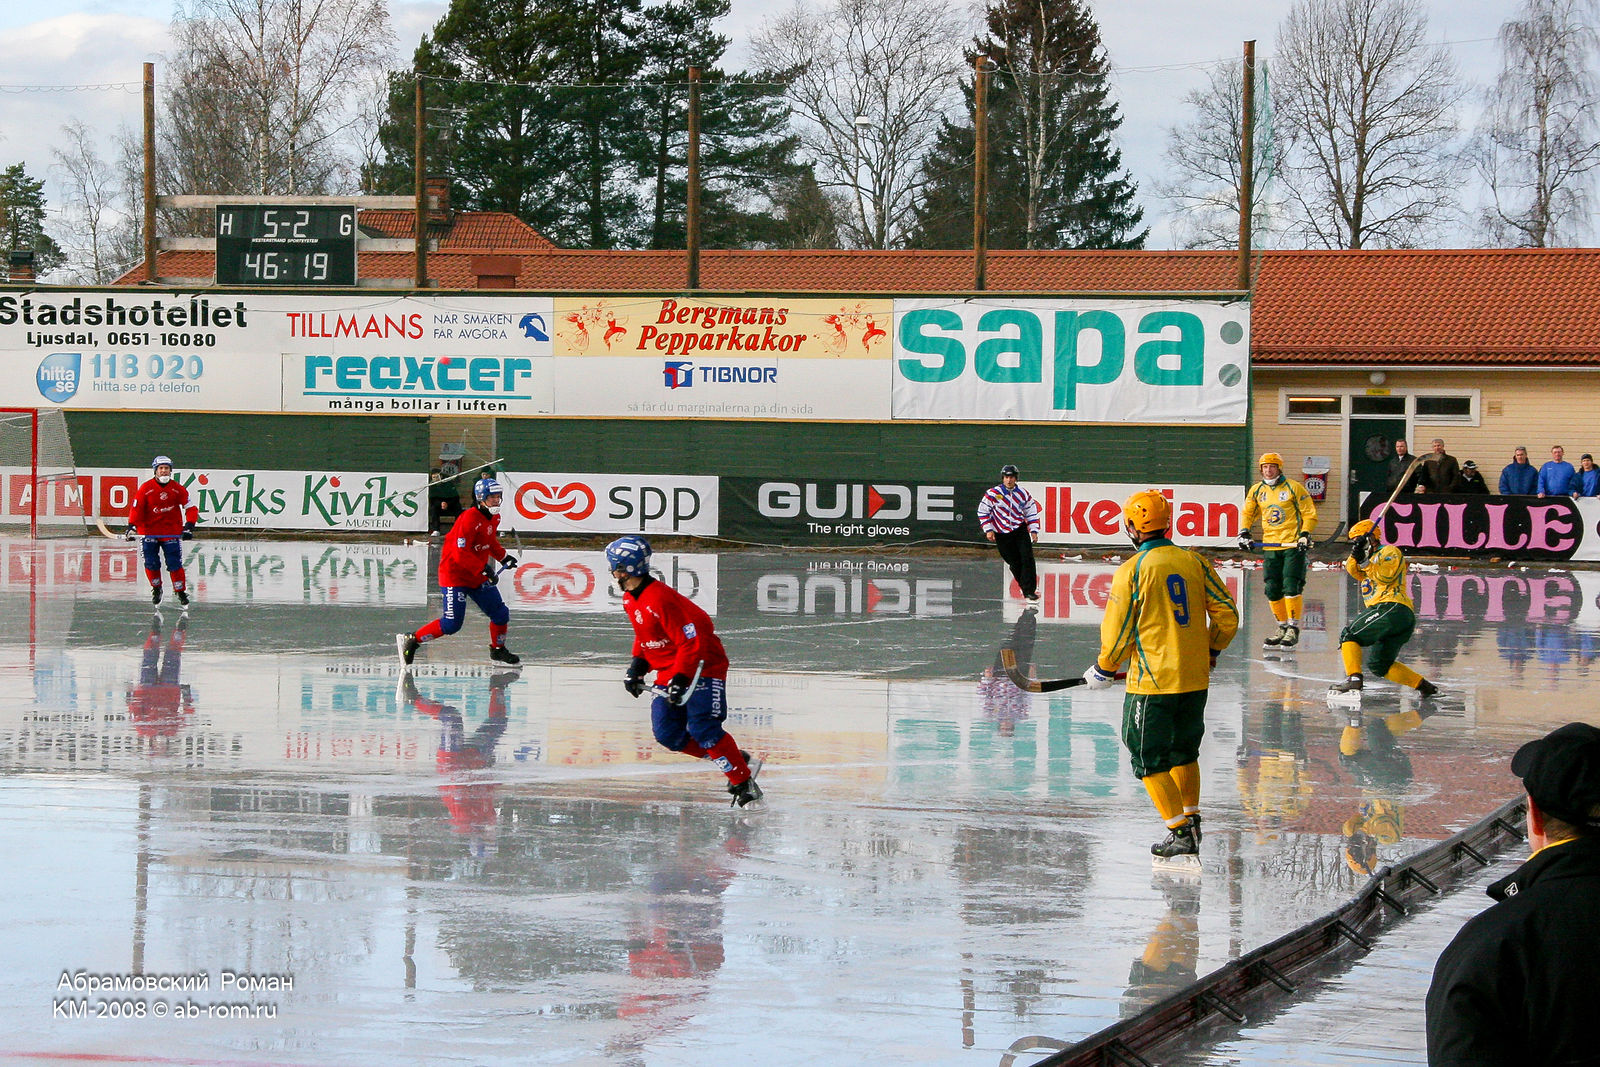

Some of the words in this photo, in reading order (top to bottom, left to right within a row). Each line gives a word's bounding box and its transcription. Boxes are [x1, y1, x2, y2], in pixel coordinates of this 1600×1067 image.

[220, 213, 233, 235] H
[263, 210, 310, 238] 5-2
[339, 214, 352, 236] G
[245, 252, 329, 280] 46:19
[0, 296, 248, 328] Stadshotellet
[433, 311, 459, 325] NÄR
[463, 313, 513, 325] SMAKEN
[655, 299, 789, 330] Bergmans
[286, 313, 424, 340] TILLMANS
[458, 326, 508, 340] AVGÖRA
[26, 331, 99, 348] Ljusdal,
[107, 331, 216, 348] 0651-16080
[636, 325, 807, 356] Pepparkakor
[40, 366, 75, 381] hitta
[89, 353, 139, 379] 118
[146, 354, 204, 380] 020
[699, 366, 778, 384] TIBNOR
[55, 380, 75, 393] se
[140, 380, 155, 394] på
[159, 381, 201, 393] telefon
[329, 397, 385, 412] många
[391, 398, 440, 411] bollar
[446, 400, 451, 411] i
[457, 399, 507, 412] luften
[659, 401, 674, 412] du
[677, 402, 750, 415] marginalerna
[769, 403, 788, 415] din
[791, 404, 814, 415] sida
[1307, 481, 1321, 490] GB
[301, 475, 419, 526] Kiviks
[608, 486, 701, 532] spp
[757, 482, 955, 521] GUIDE
[213, 516, 259, 525] MUSTERI
[345, 518, 392, 528] MUSTERI
[806, 522, 832, 534] The
[835, 524, 865, 537] right
[867, 524, 910, 537] gloves
[1369, 502, 1576, 552] GILLE
[1166, 573, 1191, 628] 9
